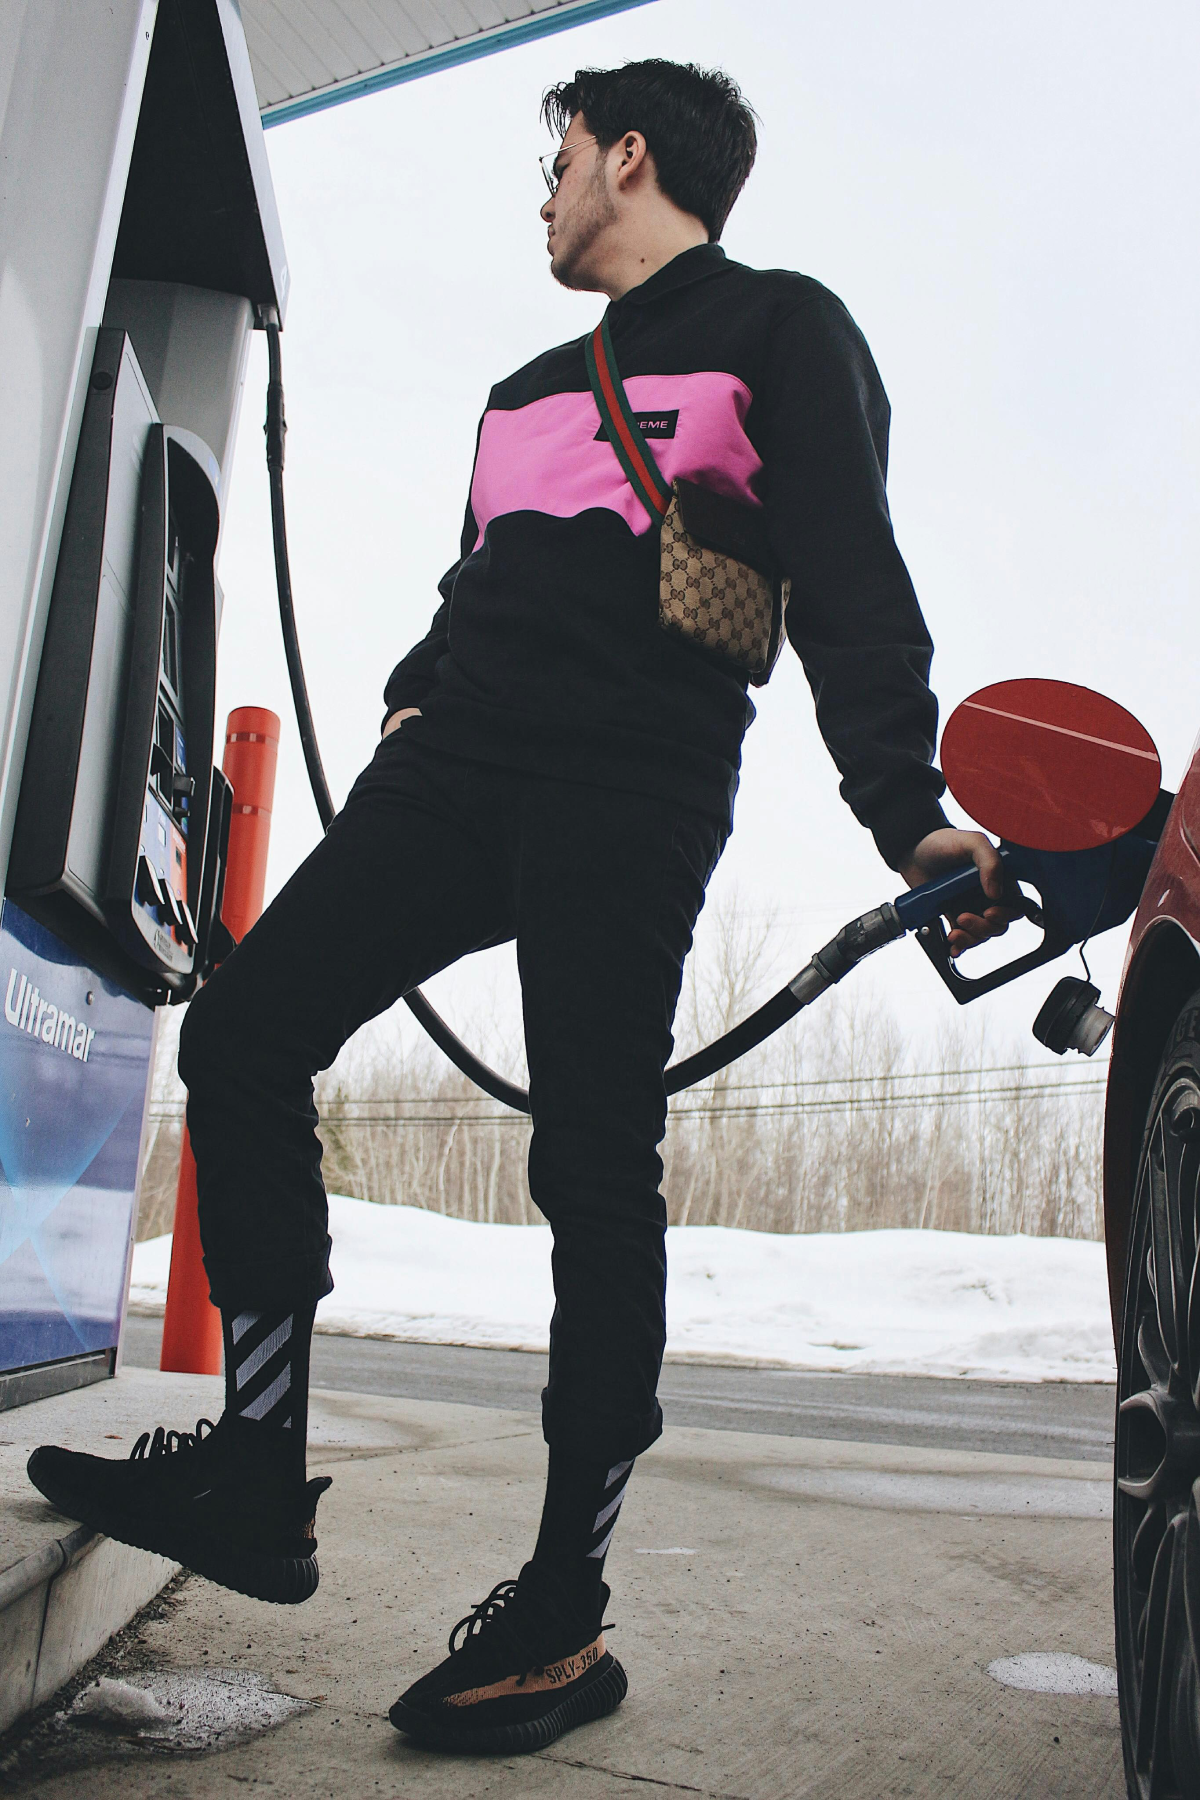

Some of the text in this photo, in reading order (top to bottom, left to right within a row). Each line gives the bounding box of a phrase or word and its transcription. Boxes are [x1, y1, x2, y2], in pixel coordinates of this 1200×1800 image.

[637, 420, 669, 429] EME
[5, 968, 96, 1063] Ultramar
[545, 1646, 598, 1684] SPLY-350
